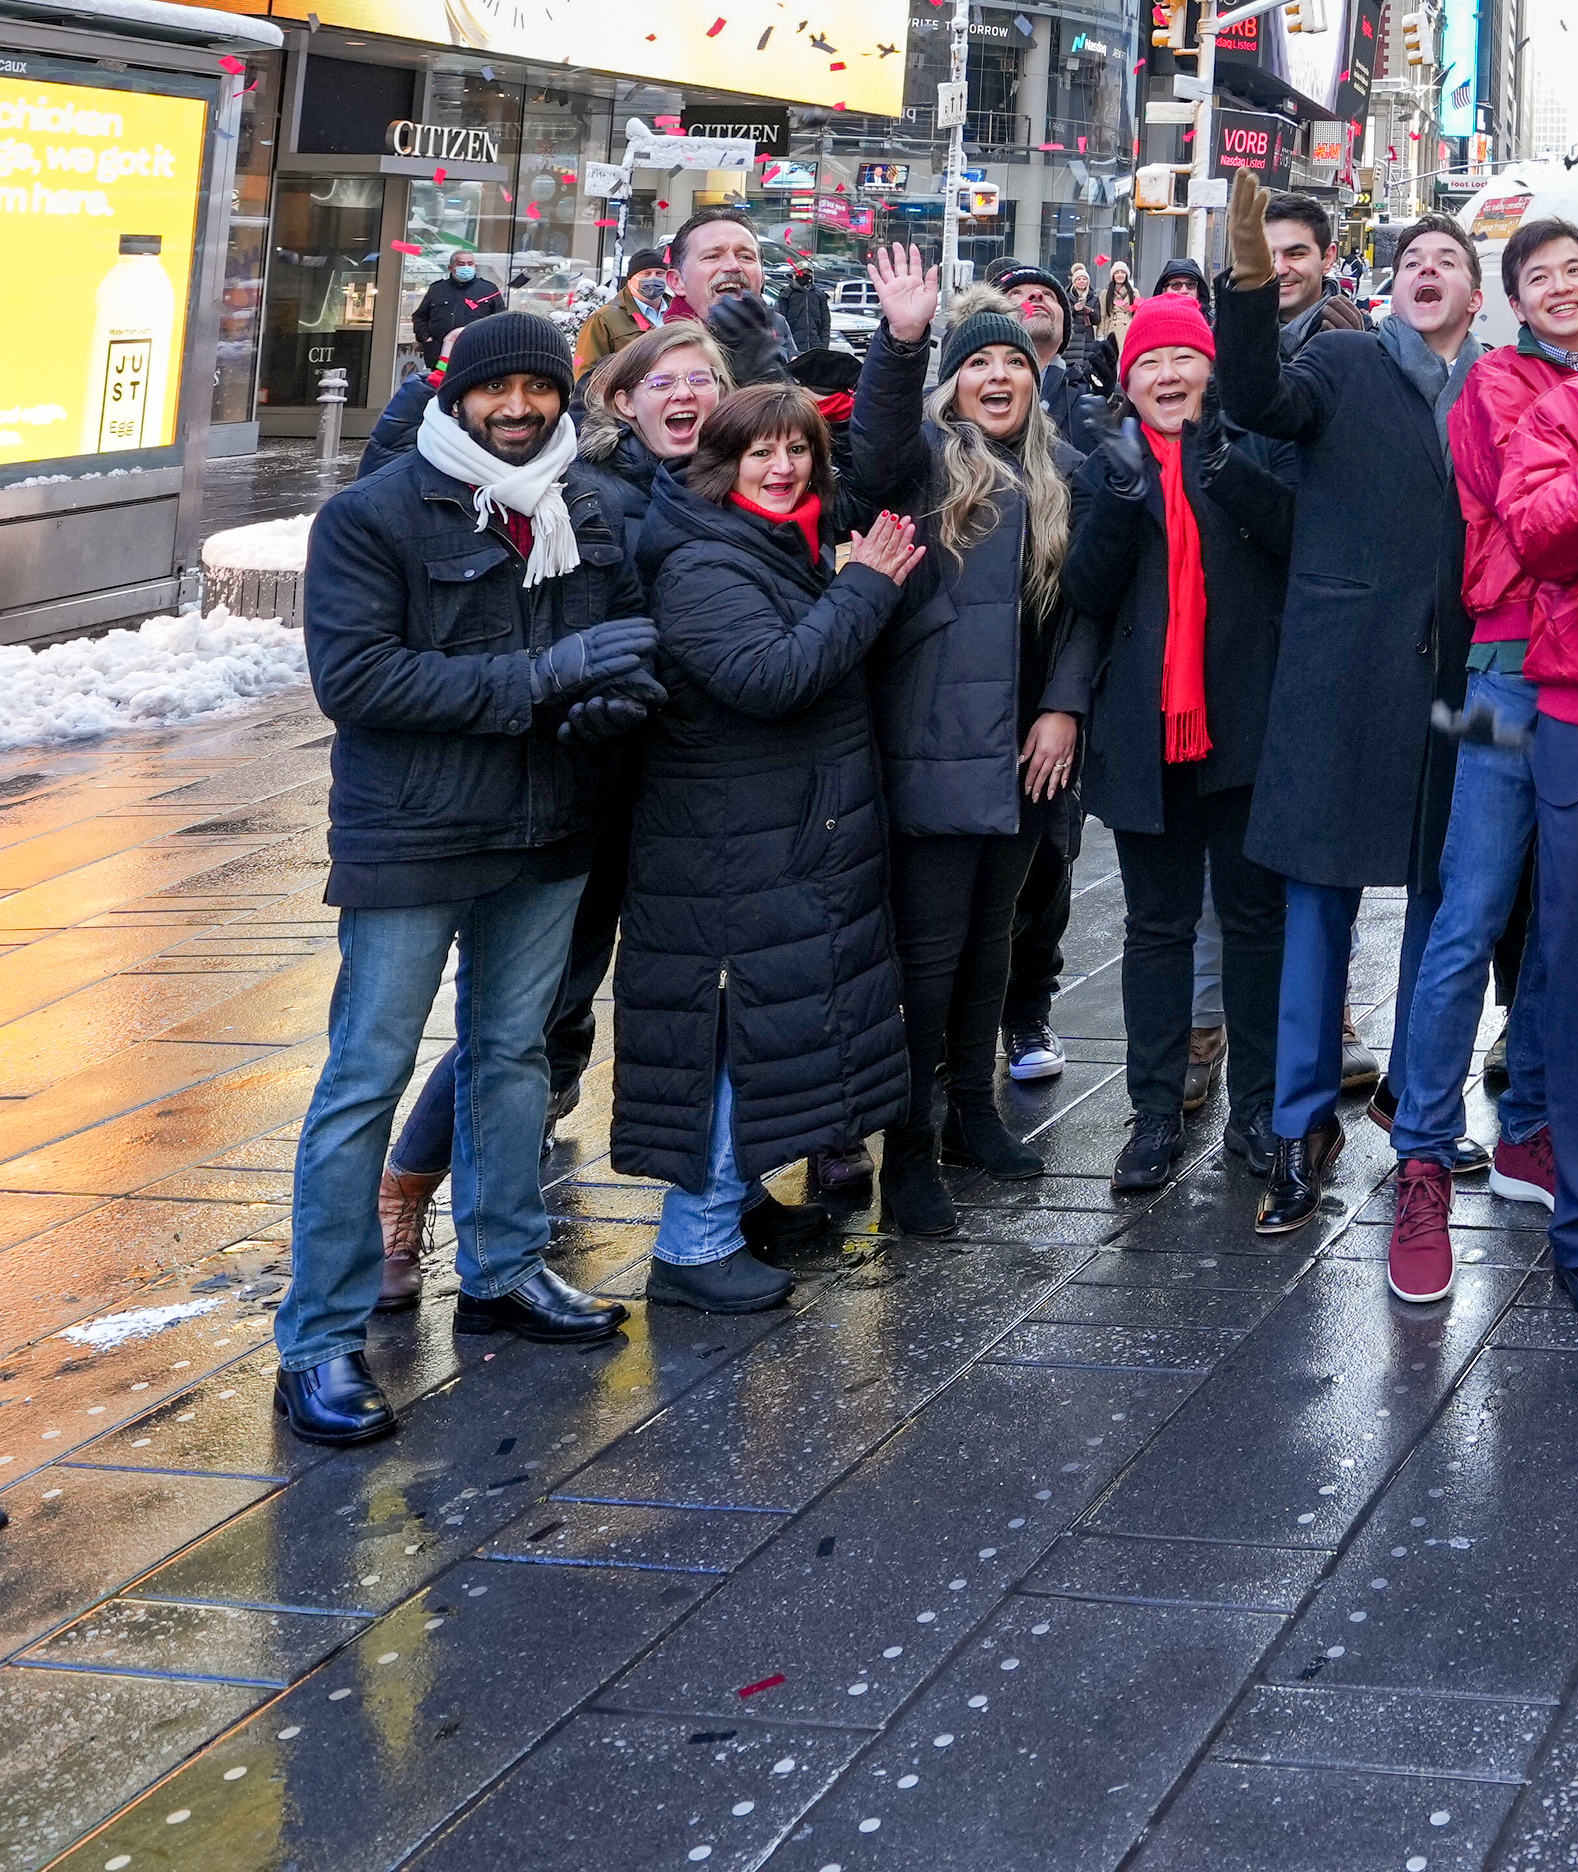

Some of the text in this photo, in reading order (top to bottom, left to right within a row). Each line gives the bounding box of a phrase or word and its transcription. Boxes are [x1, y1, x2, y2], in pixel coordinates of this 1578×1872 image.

[393, 121, 498, 162] CITIZEN
[688, 124, 780, 143] CITIZEN
[1224, 128, 1268, 155] VORB
[96, 146, 150, 183] got
[1221, 155, 1266, 169] Nasdaq Listed
[32, 182, 114, 217] here.
[110, 421, 134, 437] Egg
